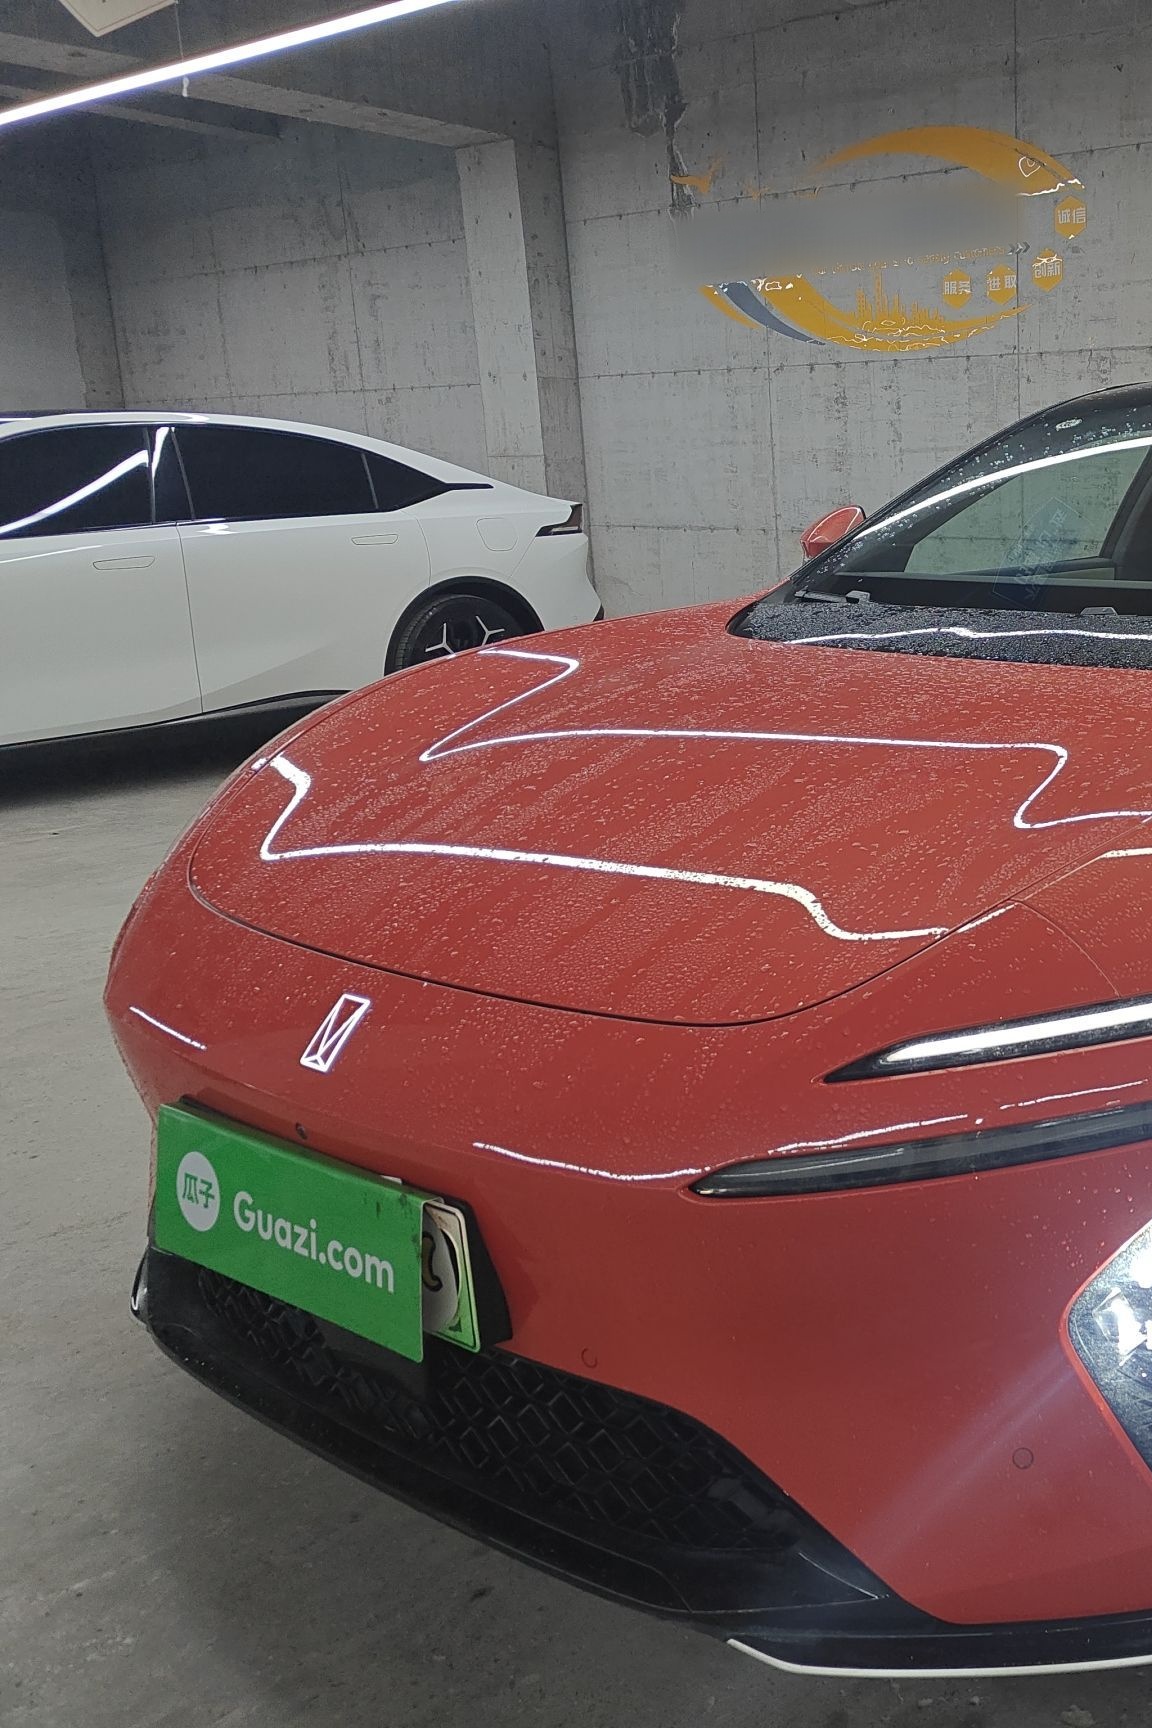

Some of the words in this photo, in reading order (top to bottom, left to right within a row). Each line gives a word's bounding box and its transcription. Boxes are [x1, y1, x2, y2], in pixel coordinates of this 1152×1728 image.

[1057, 207, 1086, 224] 诚信
[1034, 260, 1062, 278] 创新
[944, 280, 971, 295] 服务
[986, 275, 1017, 291] 进取
[182, 1172, 216, 1209] 瓜子
[233, 1190, 395, 1295] Guazi.com
